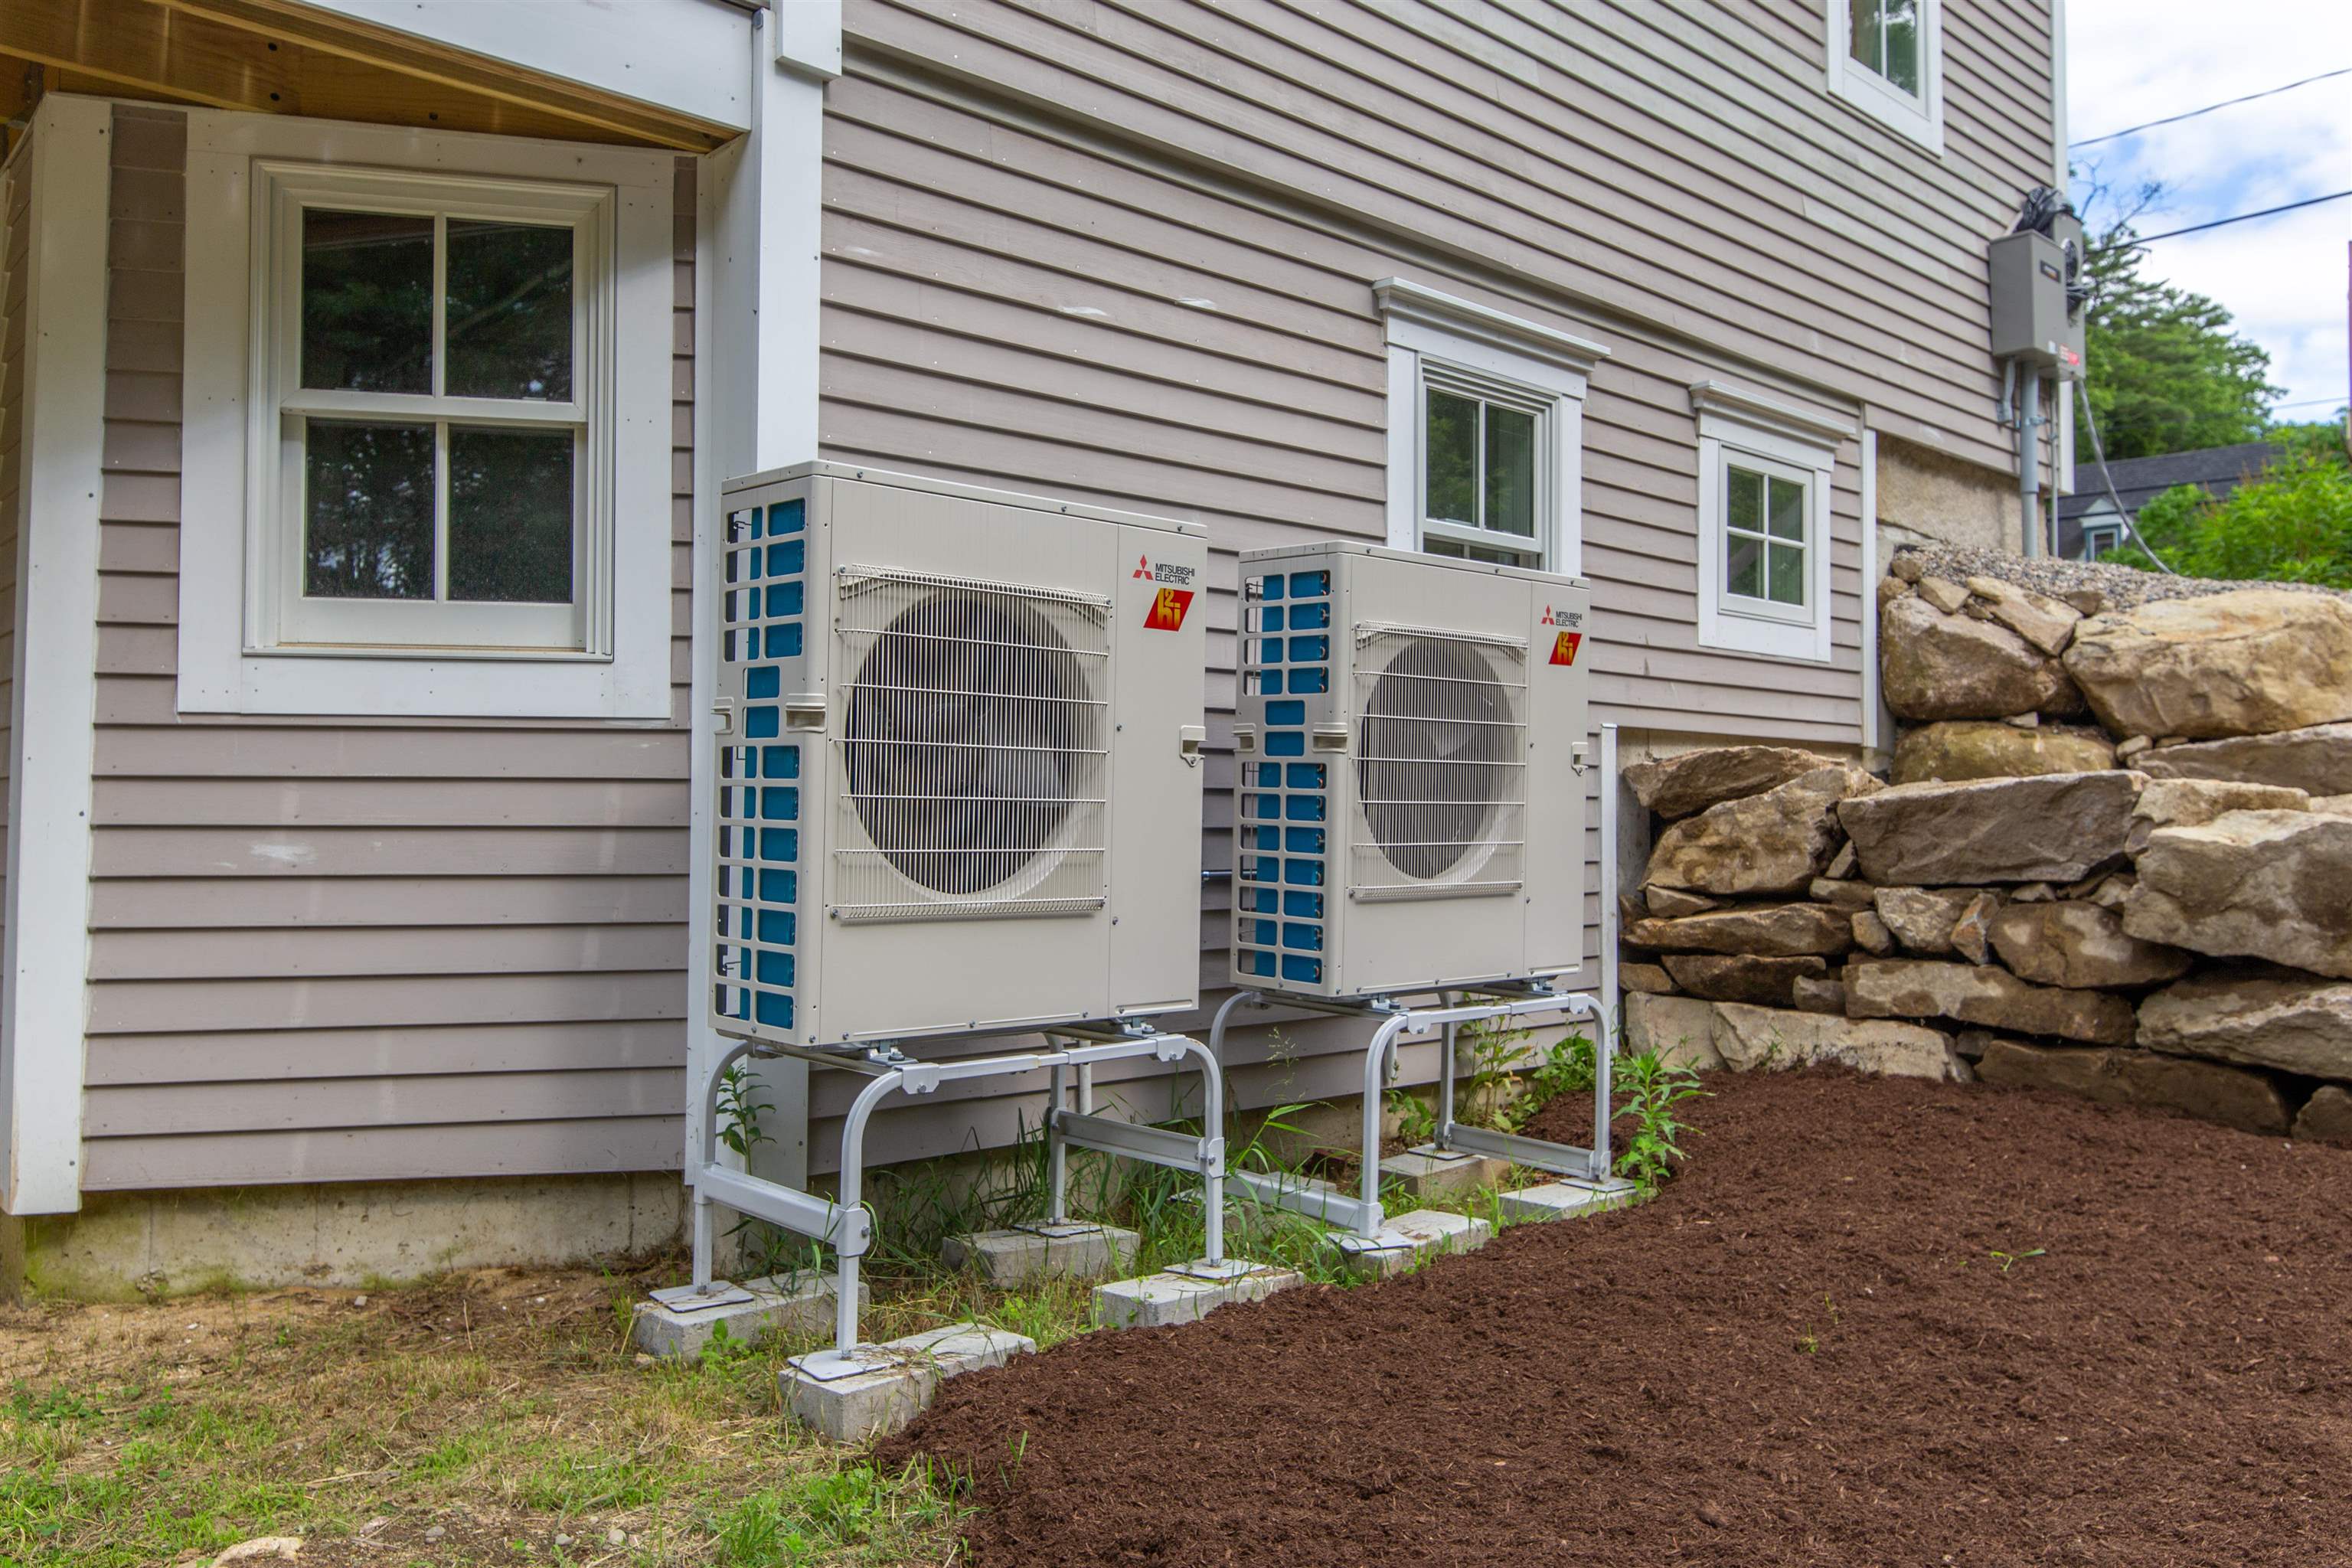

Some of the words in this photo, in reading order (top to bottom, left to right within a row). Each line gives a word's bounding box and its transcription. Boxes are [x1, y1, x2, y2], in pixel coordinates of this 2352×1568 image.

[1155, 563, 1195, 577] MITSUBISHI
[1155, 573, 1190, 585] ELECTRIC
[1556, 611, 1583, 621] MITSUBISHI
[1556, 618, 1579, 628] ELECTRIC
